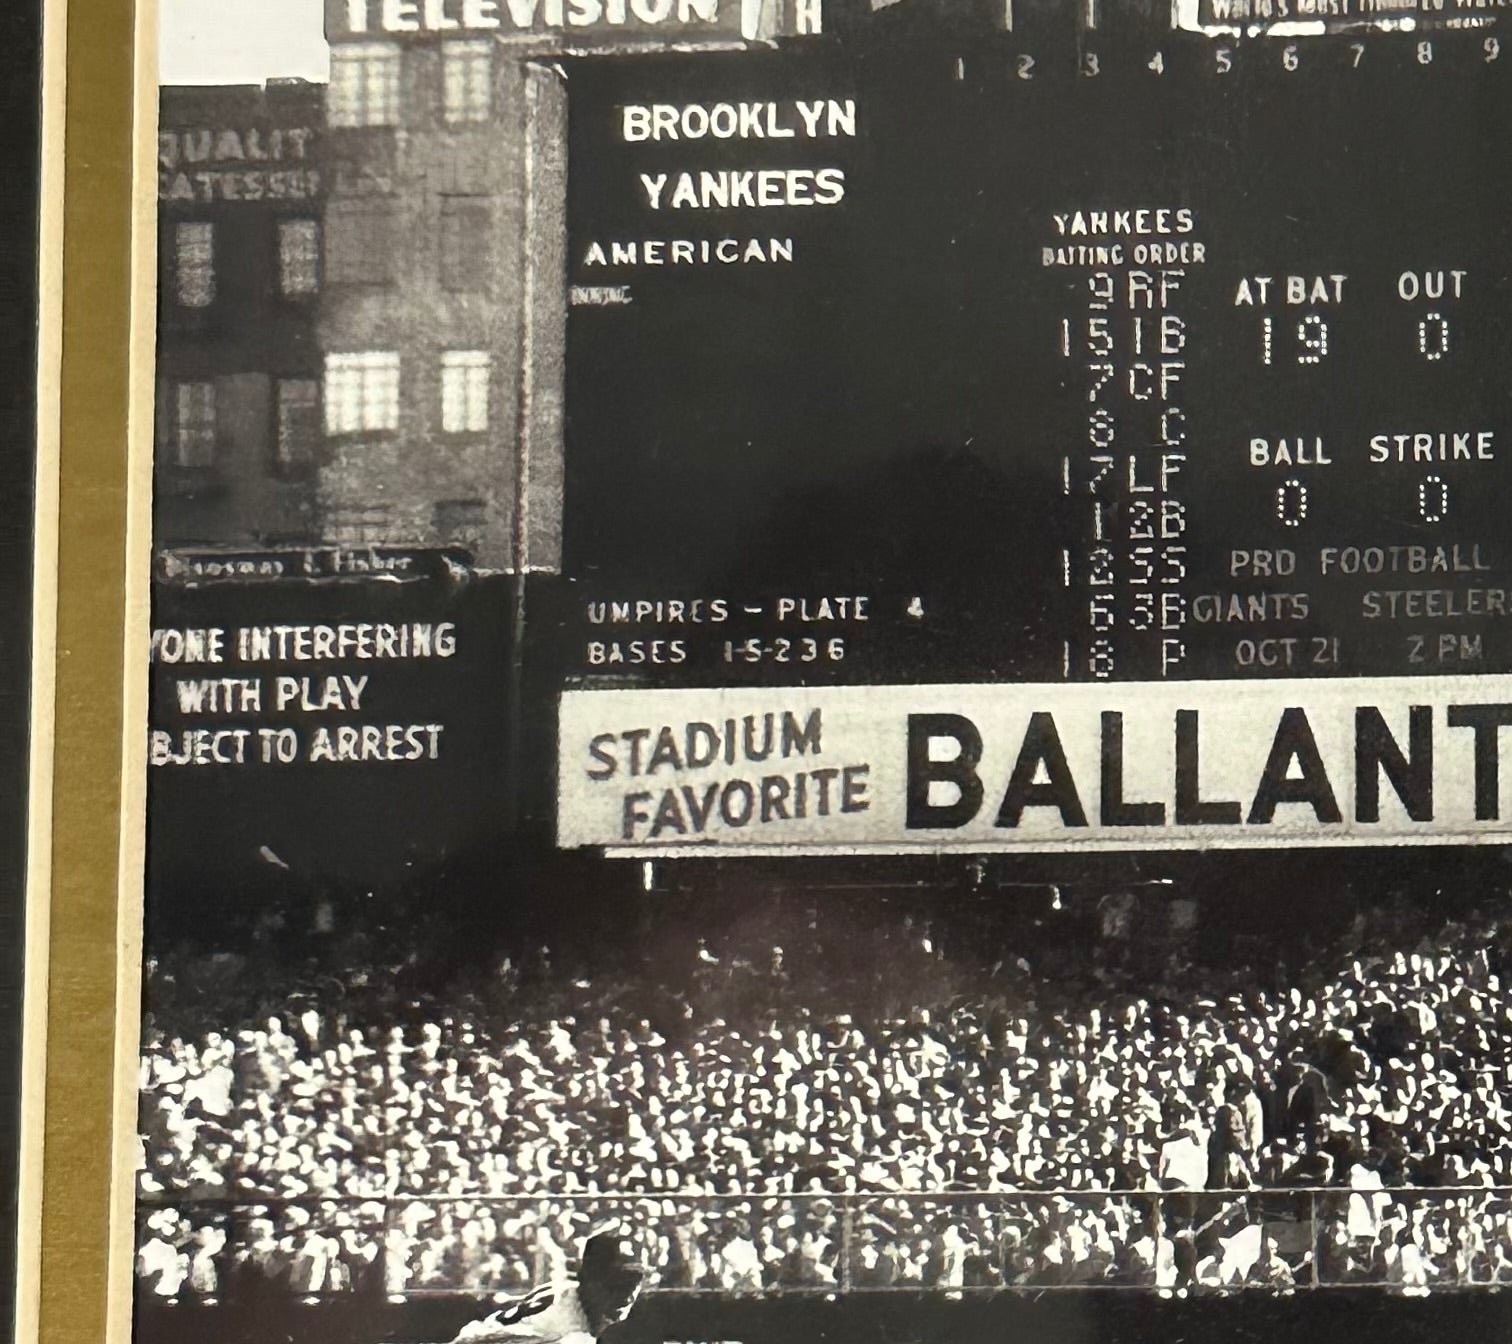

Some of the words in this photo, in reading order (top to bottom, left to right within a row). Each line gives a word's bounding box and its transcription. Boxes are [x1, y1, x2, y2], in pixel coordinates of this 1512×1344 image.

[954, 56, 965, 81] 1
[1016, 53, 1036, 80] 2
[1083, 53, 1099, 77] 3
[1148, 52, 1164, 75] 4
[1215, 48, 1232, 74] 5
[1283, 45, 1298, 71] 6
[1351, 43, 1364, 68] 7
[1418, 41, 1432, 64] 8
[1485, 37, 1500, 64] 9
[622, 100, 856, 141] BROOKLYN
[640, 169, 845, 209] YANKEES
[1053, 209, 1194, 235] YANKEES
[583, 239, 793, 266] AMERICAN
[1134, 243, 1206, 265] ORDER
[1235, 277, 1272, 306] AT
[1287, 275, 1347, 304] BAT
[1399, 271, 1467, 301] OUT
[1264, 316, 1328, 365] 19
[1420, 313, 1448, 360] 0
[1162, 407, 1186, 446] C
[1250, 438, 1331, 466] BALL
[1370, 432, 1494, 464] STRIKE
[1278, 481, 1307, 526] 0
[1419, 476, 1448, 522] 0
[1231, 550, 1296, 577] PRO
[1321, 545, 1490, 575] FOOTBALL
[587, 599, 729, 625] UMPIRES
[777, 596, 870, 622] PLATE
[1192, 593, 1310, 623] GIANTS
[238, 622, 456, 661] INTERFERING
[587, 640, 687, 665] BASES
[1162, 639, 1186, 678] P
[1235, 639, 1294, 667] OCT
[1312, 637, 1340, 664] 21
[1407, 637, 1426, 664] 2
[1438, 635, 1483, 662] PM
[177, 678, 261, 714] WITH
[276, 675, 369, 711] PLAY
[258, 728, 298, 764] TO
[309, 724, 444, 762] ARREST
[586, 708, 822, 782] STADIUM
[622, 763, 870, 839] FAVORITE
